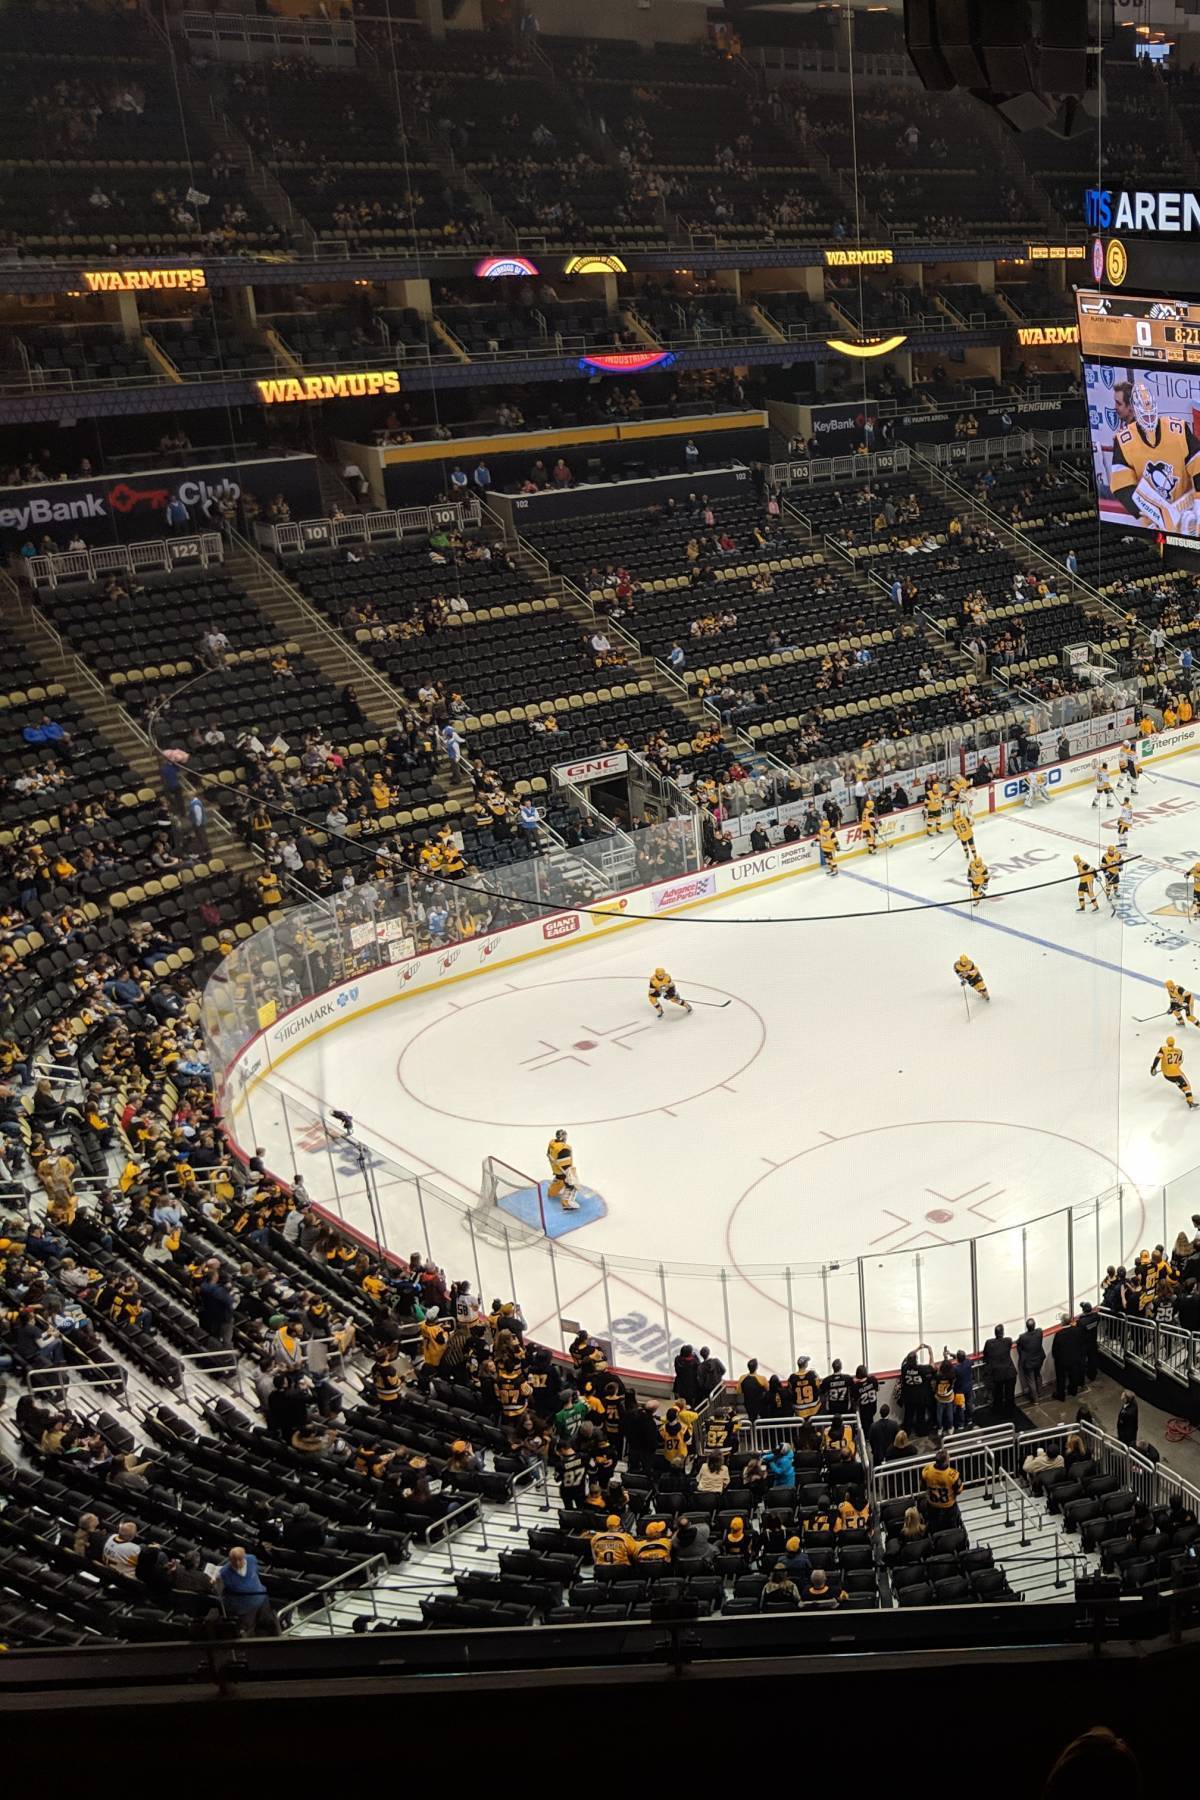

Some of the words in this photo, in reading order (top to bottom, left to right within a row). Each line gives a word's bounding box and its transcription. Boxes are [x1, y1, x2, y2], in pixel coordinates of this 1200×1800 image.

[825, 250, 893, 265] WARMUPS
[84, 269, 205, 291] WARMUPS
[1136, 321, 1152, 346] 0
[1174, 328, 1200, 343] 8:21
[258, 371, 400, 403] WARMUPS
[1018, 401, 1062, 413] PENGUINS
[813, 416, 855, 433] KeyBank
[877, 455, 893, 467] 103
[792, 467, 808, 478] 103
[515, 500, 529, 509] 102
[436, 511, 455, 522] 101
[307, 526, 328, 540] 101
[172, 543, 200, 559] 122
[567, 757, 619, 776] GNC
[1070, 763, 1091, 773] VECTOR
[781, 846, 806, 858] SPORTS
[782, 852, 811, 866] MEDICINE
[731, 856, 776, 880] UPMC
[661, 884, 696, 899] Advance
[677, 891, 696, 903] Parts
[546, 915, 576, 930] GIANT
[547, 924, 576, 939] EAGLE
[281, 1002, 334, 1042] HIGHMARK
[1167, 1053, 1179, 1065] 27
[1157, 1307, 1173, 1322] 29
[905, 1374, 922, 1386] 29
[795, 1386, 813, 1404] 19
[829, 1388, 847, 1401] 87
[860, 1390, 877, 1406] 29
[665, 1439, 679, 1451] 87
[707, 1430, 728, 1447] 87
[563, 1467, 586, 1487] 87
